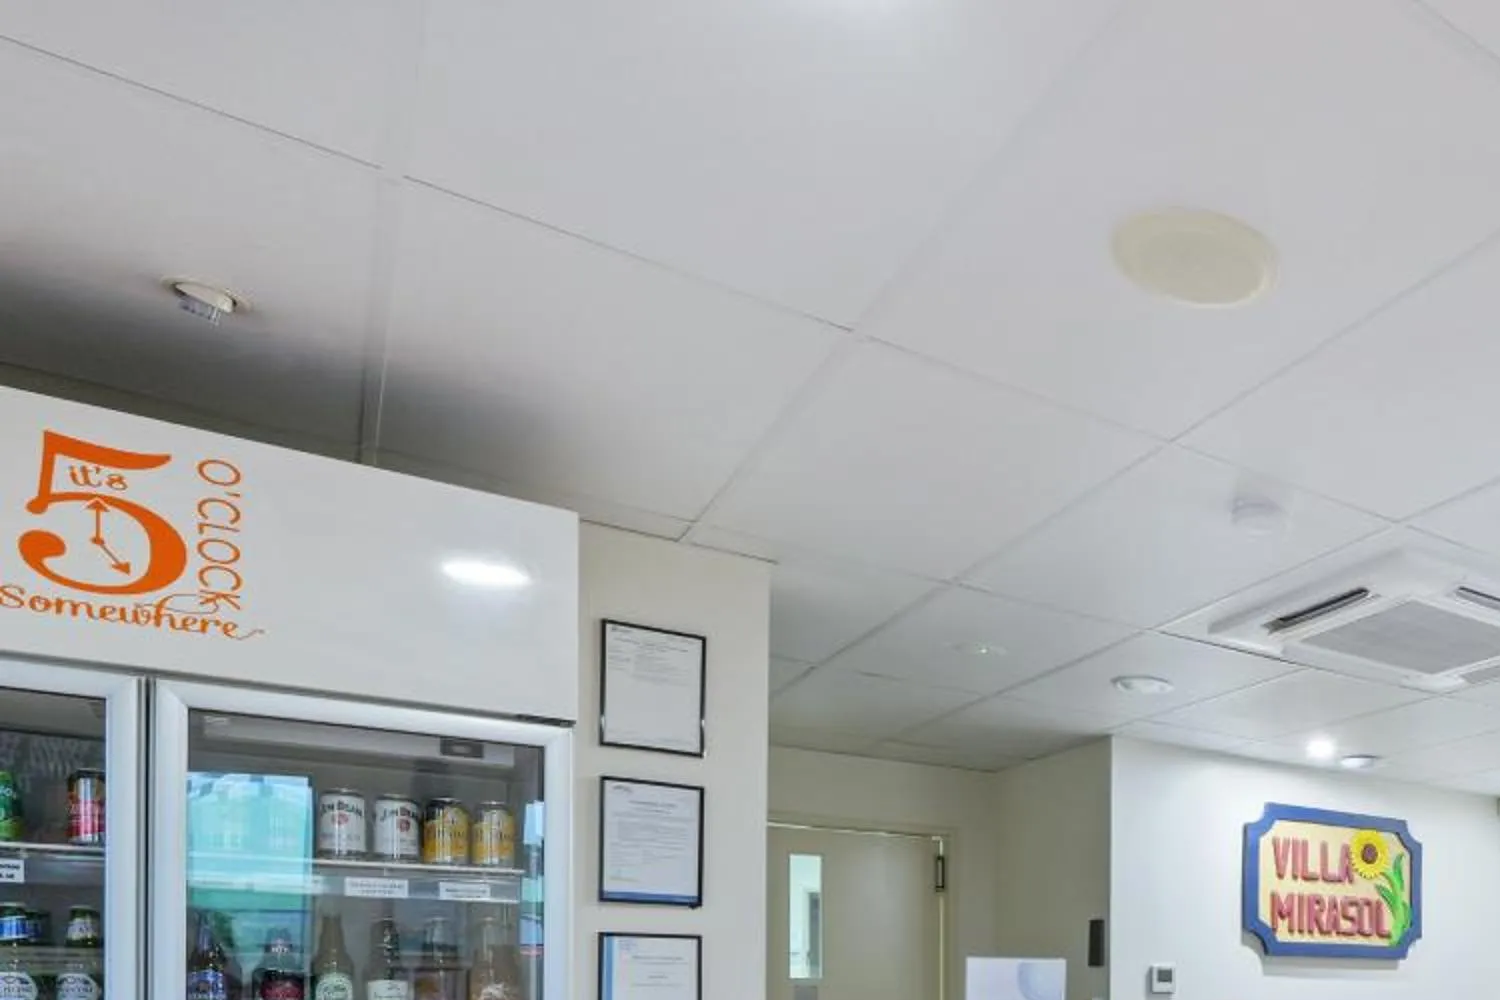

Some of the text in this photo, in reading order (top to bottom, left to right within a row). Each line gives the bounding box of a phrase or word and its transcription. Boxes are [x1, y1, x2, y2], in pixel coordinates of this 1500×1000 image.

[18, 430, 187, 595] 5
[0, 584, 265, 640] Somewhere
[1272, 836, 1354, 884] VILLA
[1270, 891, 1393, 939] MIRASOL
